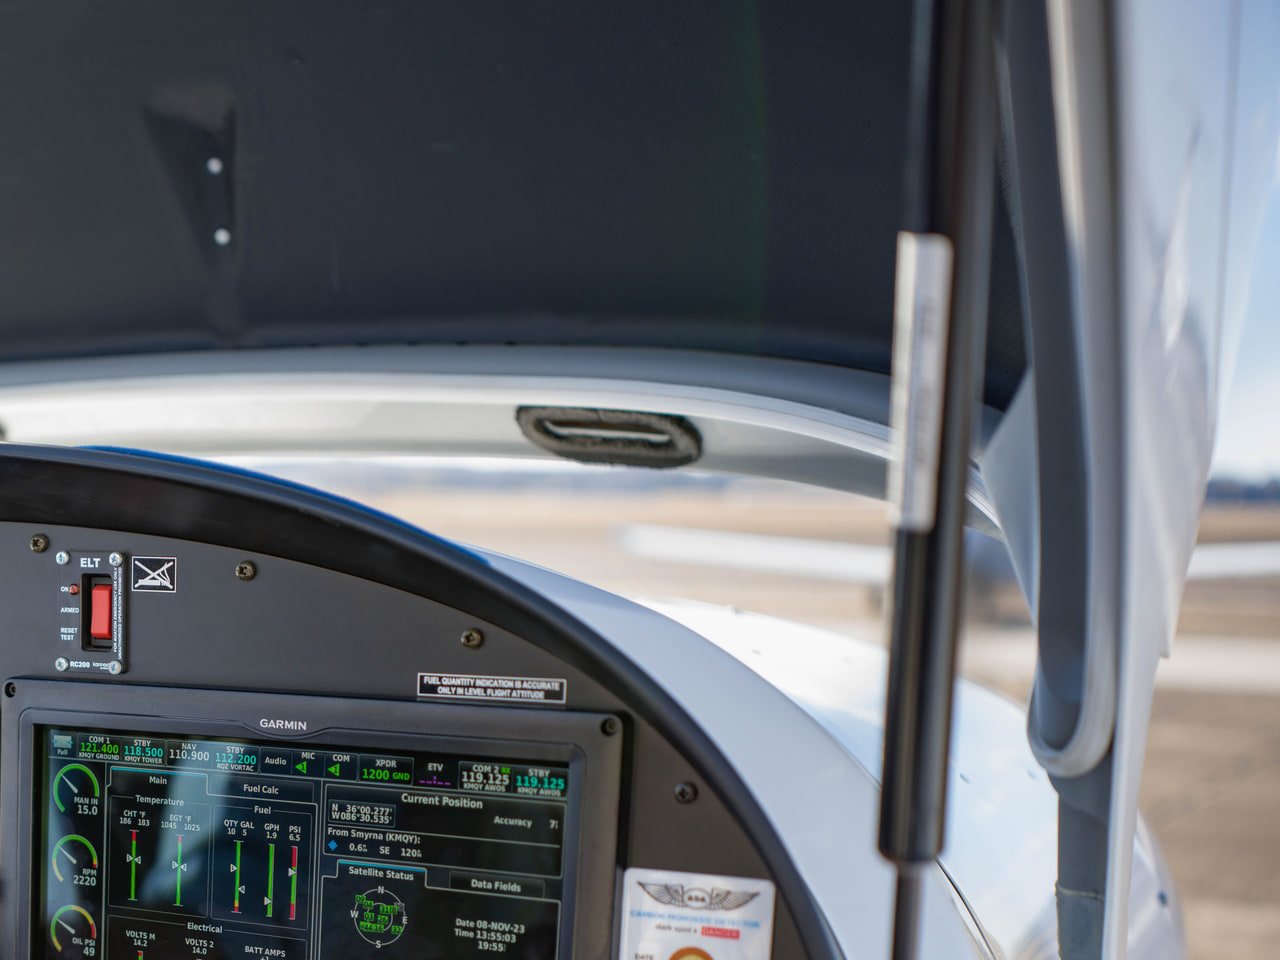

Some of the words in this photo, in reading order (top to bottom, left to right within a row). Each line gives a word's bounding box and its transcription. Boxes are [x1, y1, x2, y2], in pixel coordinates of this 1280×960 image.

[80, 558, 100, 568] ELT
[424, 676, 440, 684] FUEL
[442, 677, 474, 686] QUANTITY
[476, 679, 513, 688] INDICATION
[523, 682, 560, 690] ACCURATE
[465, 688, 486, 696] LEVEL
[512, 691, 544, 699] ATTITUDE
[260, 718, 307, 731] GARMIN
[80, 743, 119, 754] 121.400
[133, 739, 151, 747] STBY
[124, 746, 163, 757] 118.500
[169, 750, 210, 761] 110.900
[226, 746, 244, 754] STBY
[216, 753, 257, 765] 112.200
[265, 756, 287, 766] Audio
[301, 752, 315, 760] MIC
[332, 754, 350, 762] COM
[376, 759, 397, 768] XPDR
[428, 763, 443, 772] ETV
[363, 768, 389, 780] 1200
[392, 771, 410, 781] GND
[461, 772, 509, 785] 119.125
[149, 776, 168, 785] Main
[515, 776, 565, 789] 119.125
[243, 784, 260, 793] Fuel
[262, 785, 279, 795] Calc
[136, 795, 184, 807] Temperature
[401, 793, 439, 806] Current
[442, 796, 483, 809] Position
[77, 805, 98, 816] 15.0
[254, 805, 271, 815] Fuel
[264, 823, 280, 831] GPH
[494, 816, 532, 829] Accuracy
[289, 833, 300, 841] 6.5
[82, 868, 97, 876] RPM
[349, 866, 384, 878] Satellite
[386, 868, 414, 881] Status
[73, 875, 97, 886] 2220
[471, 879, 492, 889] Data
[495, 882, 521, 892] Fields
[187, 922, 222, 933] Electrical
[456, 918, 474, 928] Date
[476, 920, 525, 934] 08-NOV-23
[454, 928, 474, 938] Time
[476, 930, 517, 943] 13:55:03
[133, 938, 147, 947] 14.2
[83, 947, 95, 956] 49
[192, 946, 207, 955] 14.0
[245, 946, 262, 955] BATT
[265, 949, 286, 958] AMPS
